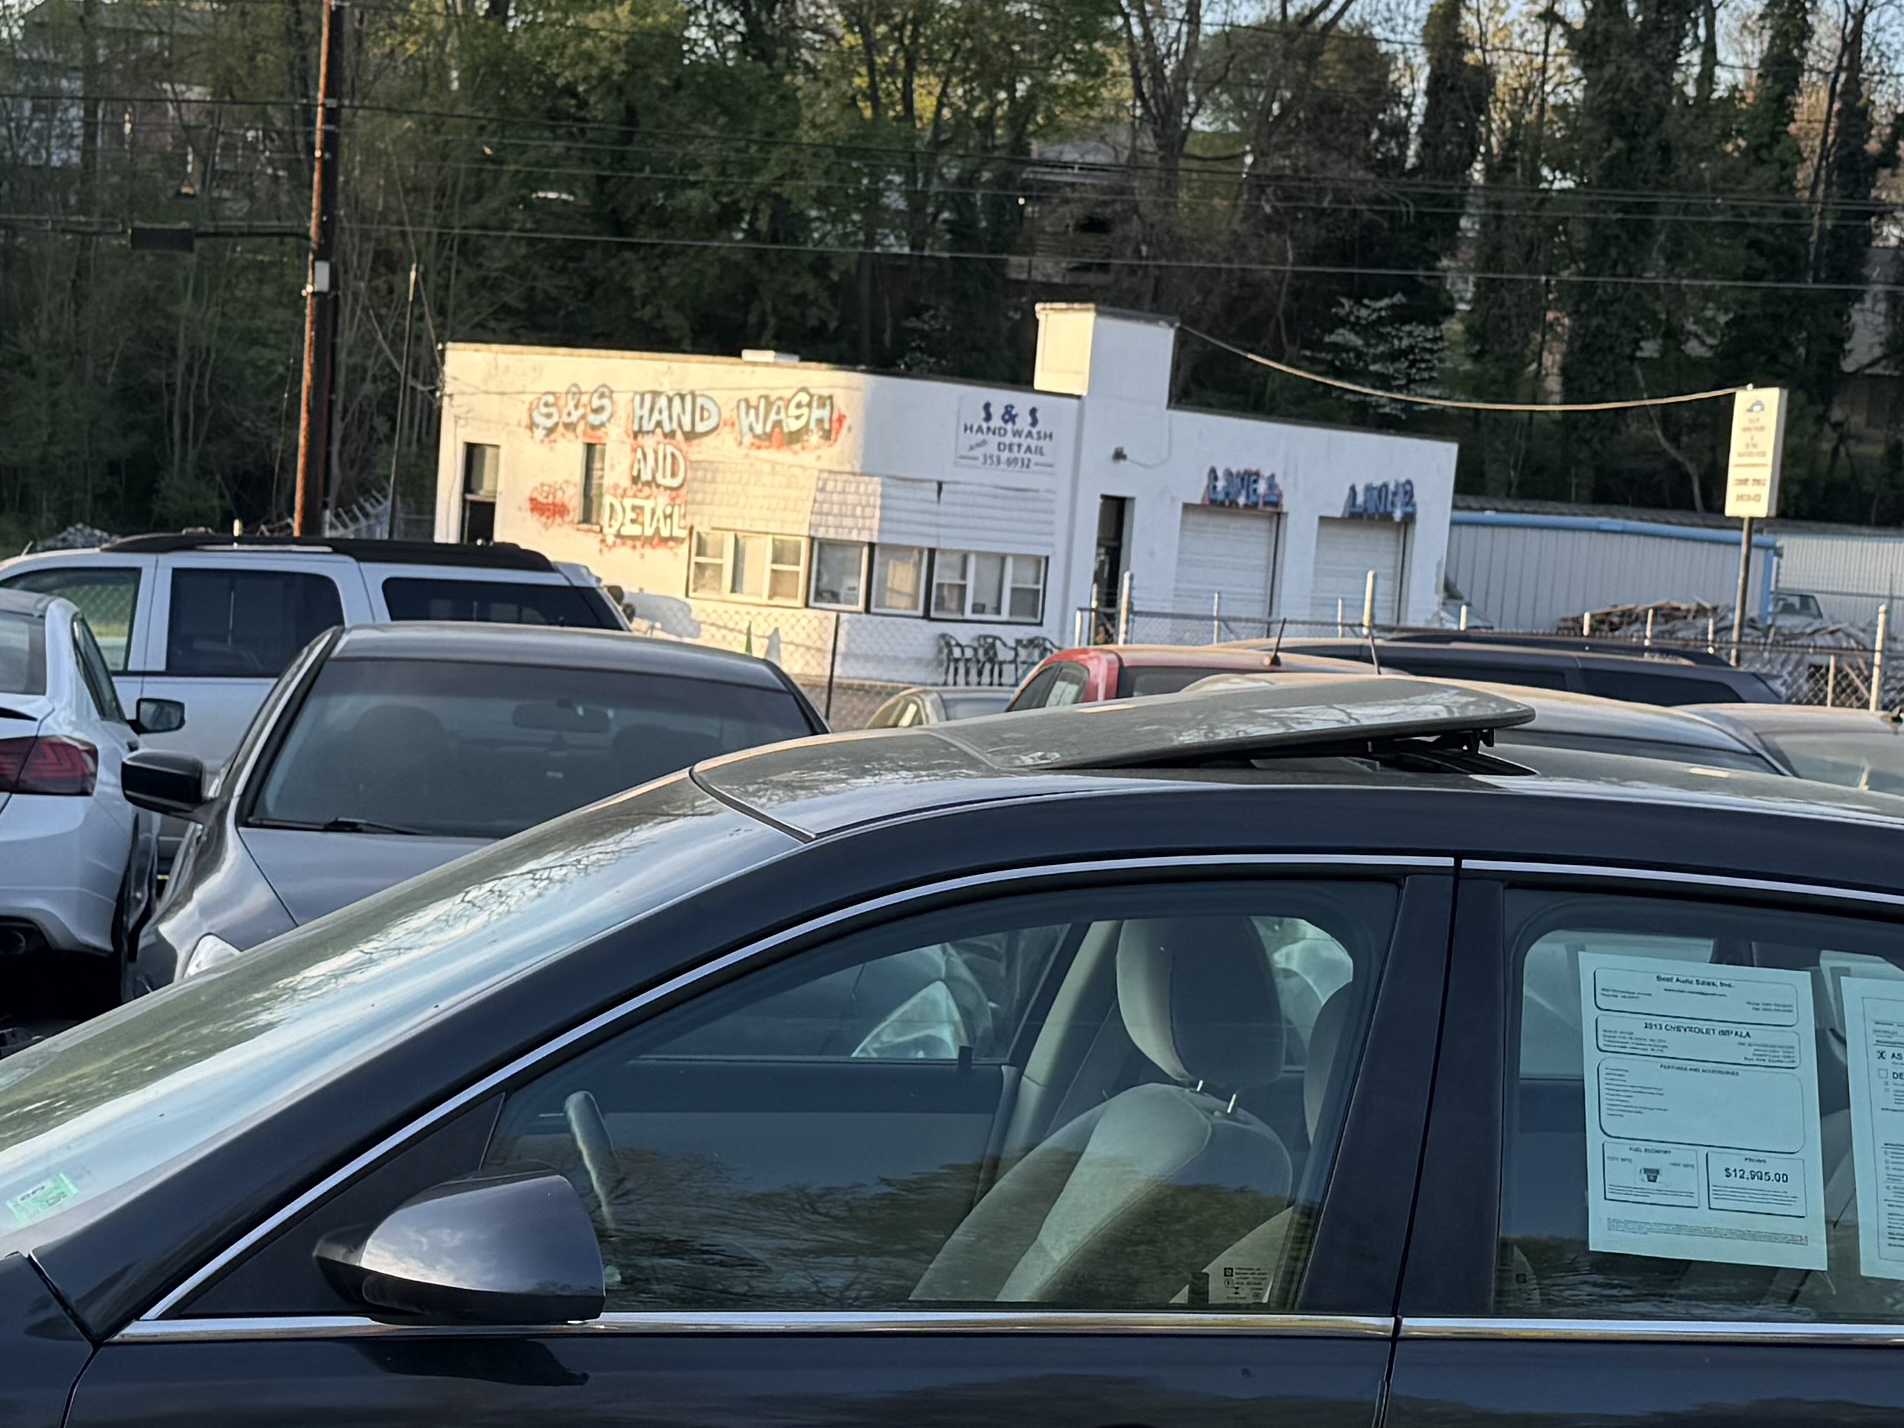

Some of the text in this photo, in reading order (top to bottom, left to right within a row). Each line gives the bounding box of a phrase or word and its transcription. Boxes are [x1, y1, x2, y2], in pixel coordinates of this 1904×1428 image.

[632, 389, 722, 440] HAND
[736, 386, 835, 441] WASH
[963, 423, 1053, 442] HAND WASH
[997, 441, 1045, 457] DETAIL
[631, 442, 687, 489] AND
[1664, 1023, 1716, 1036] CHEVROLET
[1890, 1052, 1904, 1061] AS
